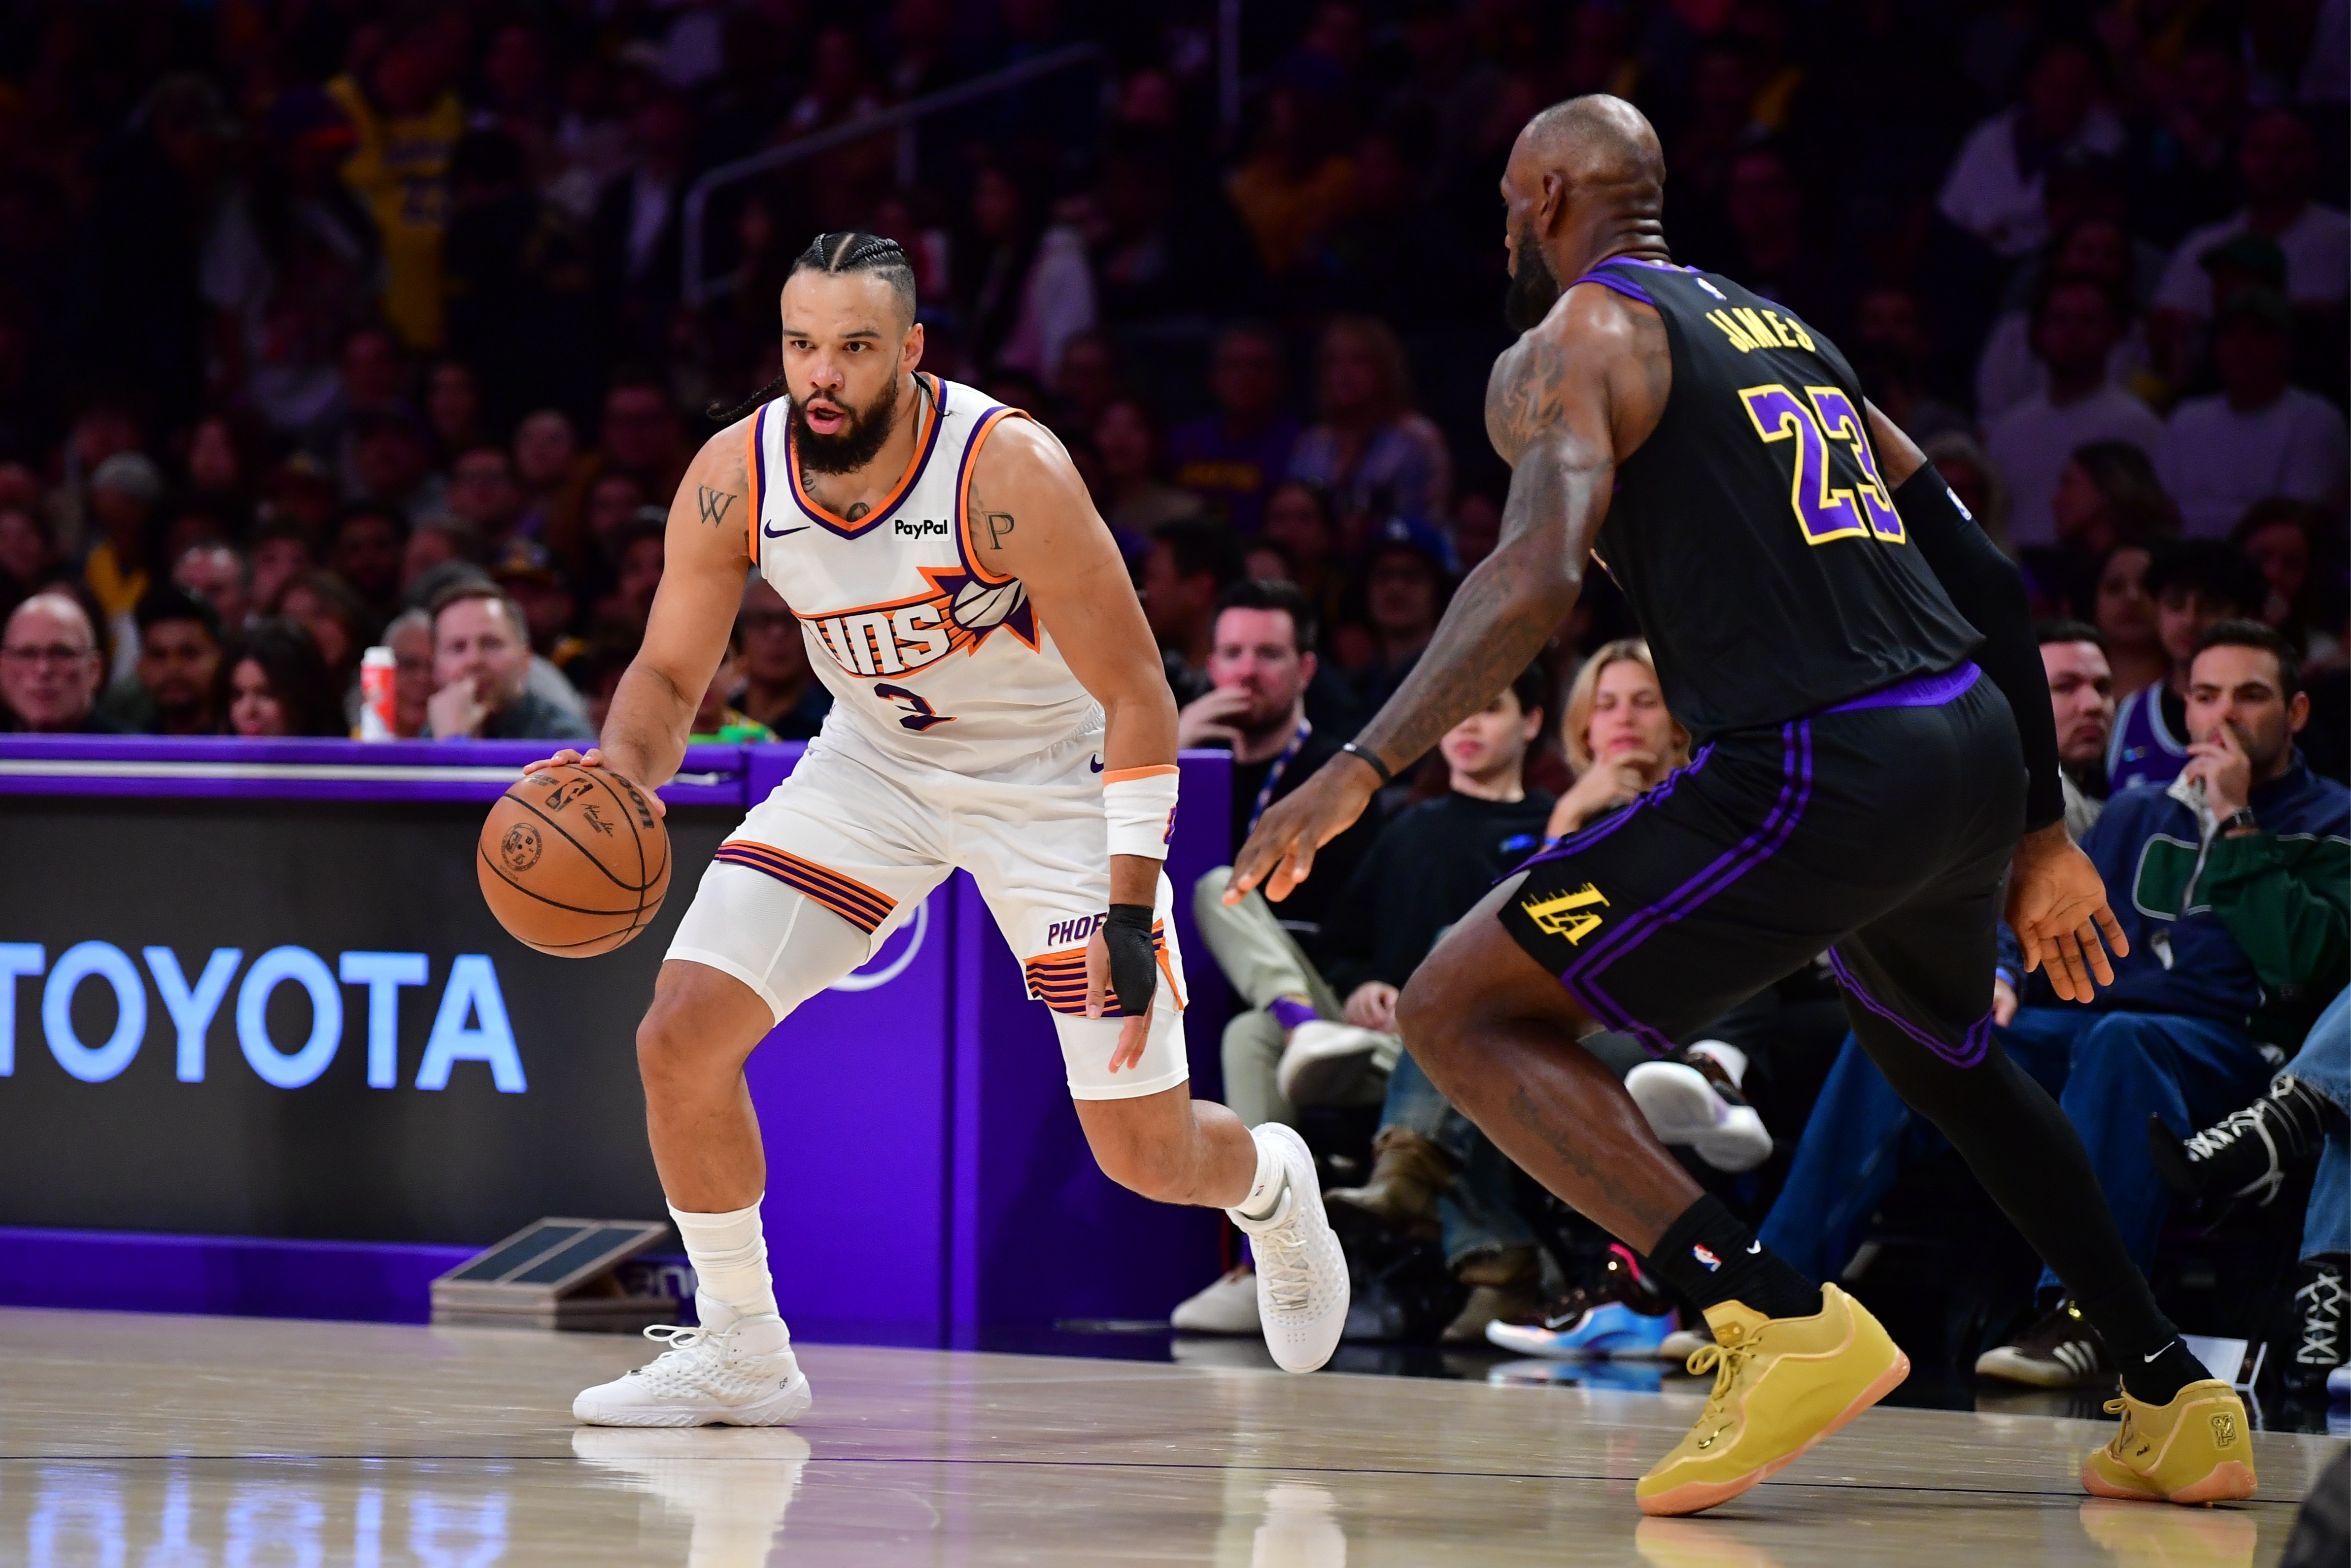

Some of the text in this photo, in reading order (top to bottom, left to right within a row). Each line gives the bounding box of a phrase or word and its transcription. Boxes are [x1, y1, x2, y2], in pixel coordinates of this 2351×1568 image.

[1705, 307, 1815, 353] JAMES
[1738, 384, 1906, 546] 23
[698, 483, 737, 528] W
[894, 519, 948, 540] PayPal
[982, 511, 1015, 550] P
[800, 603, 950, 675] UNS
[1048, 912, 1108, 947] PHOE
[1521, 882, 1610, 946] LA
